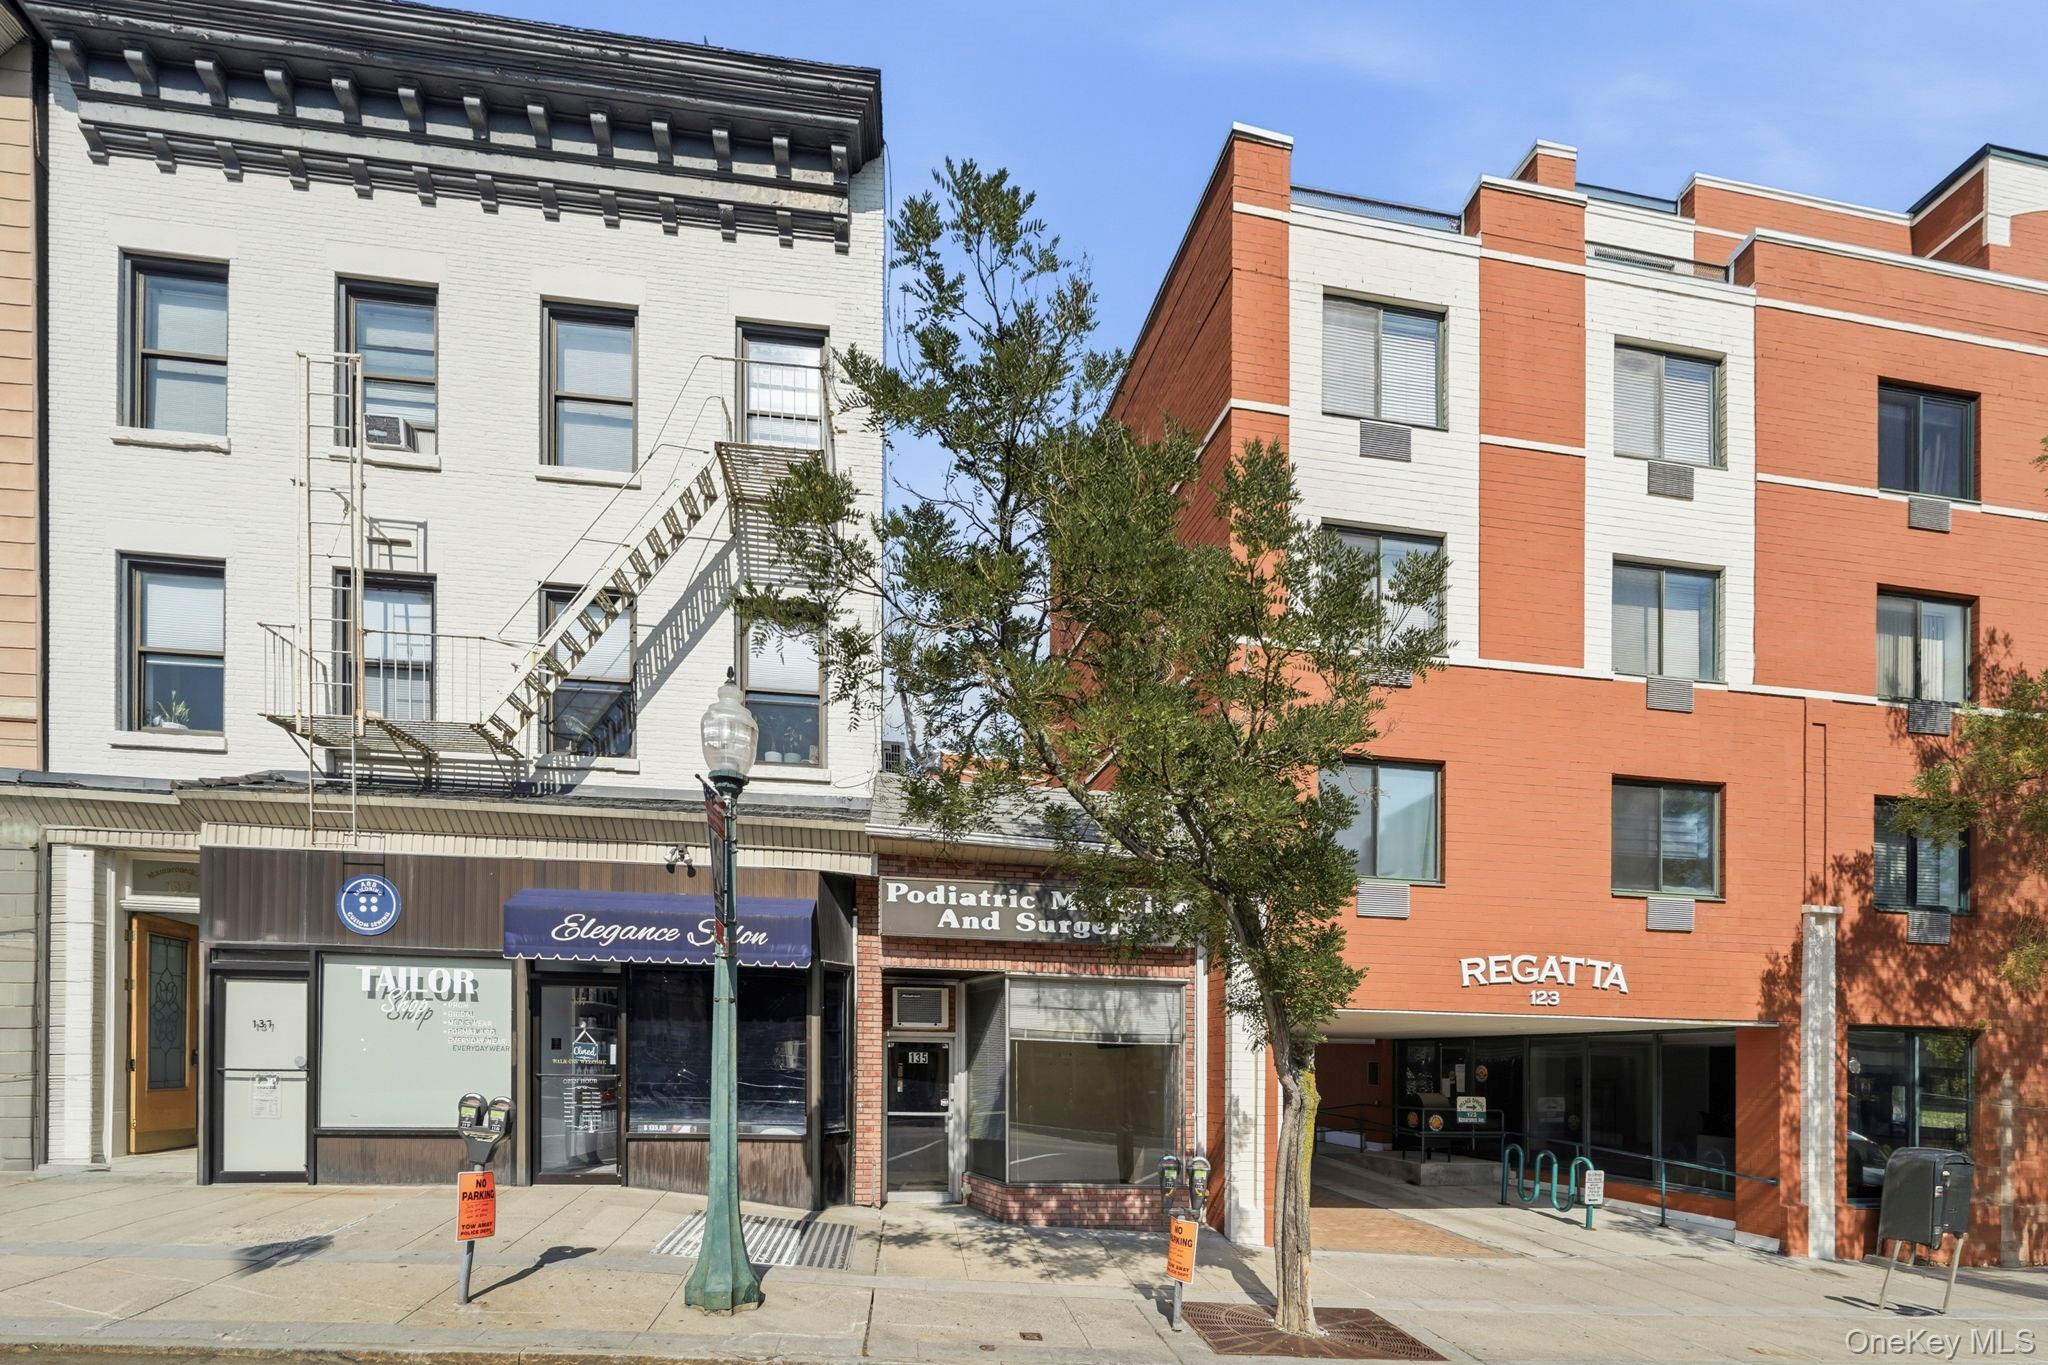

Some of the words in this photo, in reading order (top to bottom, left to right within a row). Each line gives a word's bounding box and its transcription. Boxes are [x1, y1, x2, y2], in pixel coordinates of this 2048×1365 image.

[886, 882, 1036, 909] Podiatric
[347, 911, 369, 928] CUSTOM
[937, 909, 1000, 931] And
[550, 913, 680, 947] Elegance
[687, 918, 769, 947] Slon
[356, 966, 475, 994] TAILOR
[1459, 954, 1629, 994] REGATTA
[381, 987, 430, 1023] Shop
[1529, 989, 1561, 1006] 123
[909, 1051, 928, 1064] 135
[475, 1178, 487, 1189] NO
[461, 1189, 495, 1202] PARKING
[461, 1222, 477, 1230] TOW
[477, 1221, 493, 1229] AWAY
[1174, 1224, 1183, 1235] NO
